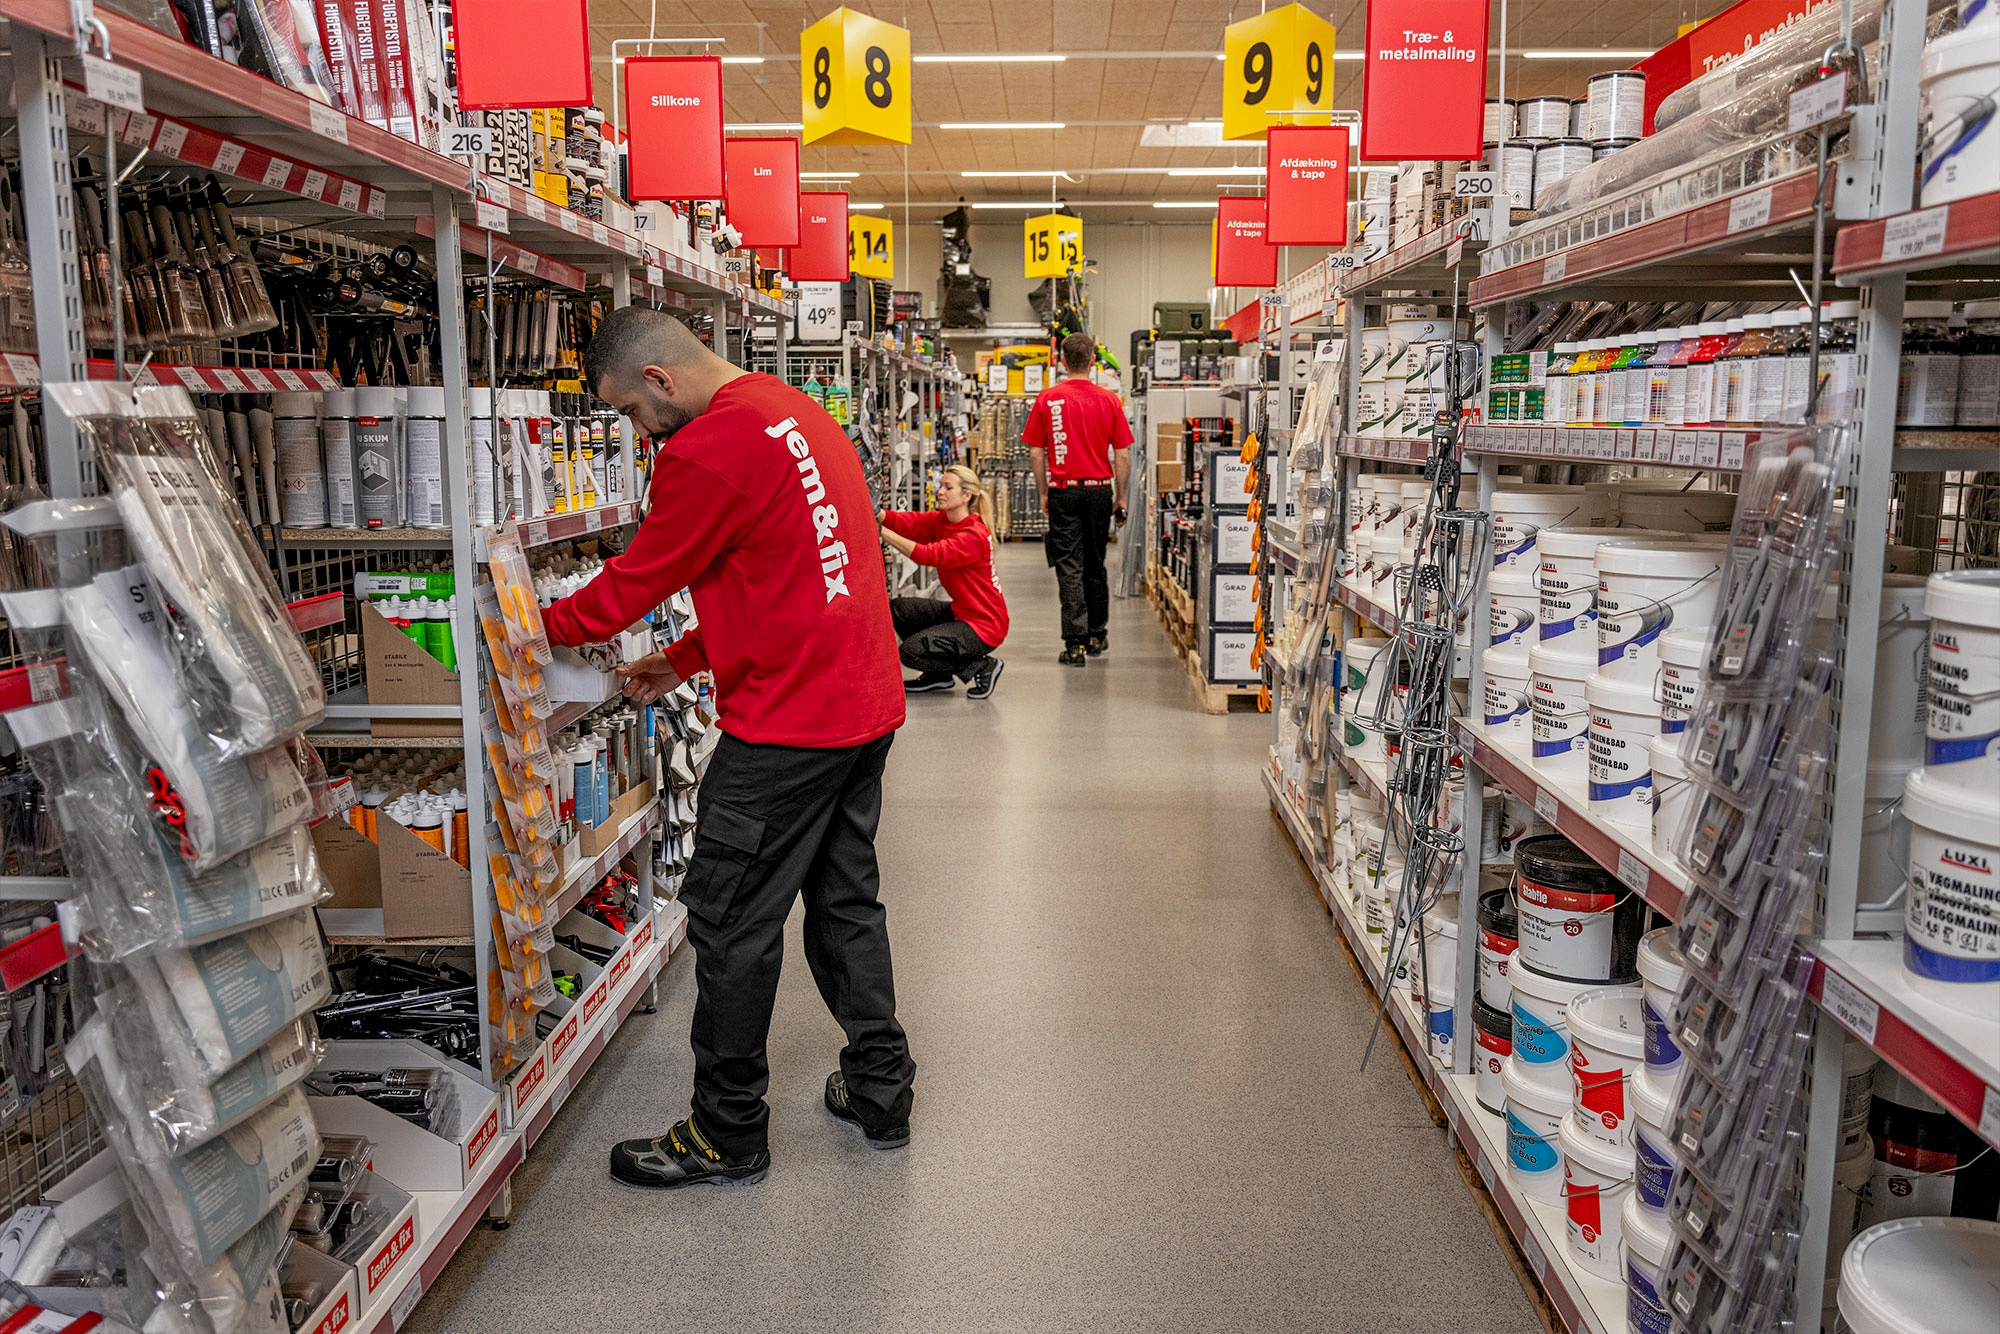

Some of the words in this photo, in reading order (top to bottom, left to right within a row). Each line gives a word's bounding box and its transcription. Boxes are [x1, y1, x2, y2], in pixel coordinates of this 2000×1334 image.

[324, 3, 345, 63] FUGEPISTOL
[354, 1, 375, 61] FUGEPISTOL
[382, 0, 402, 59] FUGEPISTOL
[1403, 30, 1438, 43] Træ-
[1443, 30, 1454, 44] &
[1379, 47, 1476, 62] metalmaling
[814, 46, 831, 109] 8
[865, 46, 892, 108] 8
[1243, 42, 1272, 105] 9
[1306, 42, 1322, 105] 9
[651, 96, 700, 107] Silikone
[452, 134, 483, 151] 216
[754, 168, 772, 177] Lim
[1279, 158, 1337, 172] Afdækning
[1291, 169, 1300, 179] &
[1302, 169, 1326, 181] tape
[1459, 178, 1493, 195] 250
[634, 216, 648, 229] 17
[811, 216, 827, 224] Lim
[1227, 221, 1266, 229] Afdæknin
[1235, 229, 1242, 237] &
[1243, 229, 1262, 238] tape
[863, 231, 889, 263] 14
[1030, 230, 1049, 262] 15
[726, 261, 741, 272] 218
[1331, 256, 1354, 268] 249
[785, 290, 799, 300] 219
[1264, 296, 1282, 305] 248
[364, 434, 389, 442] SKUM
[1047, 399, 1068, 465] jem&fix
[764, 416, 851, 604] jem&fix
[1934, 632, 1957, 647] LUXI
[1666, 667, 1679, 676] LUXI
[1536, 680, 1552, 690] LUXI
[1682, 686, 1695, 694] BAD
[1593, 715, 1610, 725] LUXI
[1944, 848, 1987, 868] LUXI
[1927, 904, 2000, 937] VEGGMALIN
[1566, 926, 1579, 934] 20
[597, 985, 606, 1001] fix
[568, 1020, 577, 1037] fix
[1527, 1042, 1546, 1056] BAD
[535, 1063, 544, 1081] fix
[488, 1116, 497, 1134] fix
[1519, 1150, 1537, 1165] BAD
[1892, 1184, 1908, 1195] 25
[370, 1253, 390, 1287] jem
[390, 1241, 400, 1259] &
[399, 1226, 411, 1249] fix
[332, 1303, 347, 1329] fix
